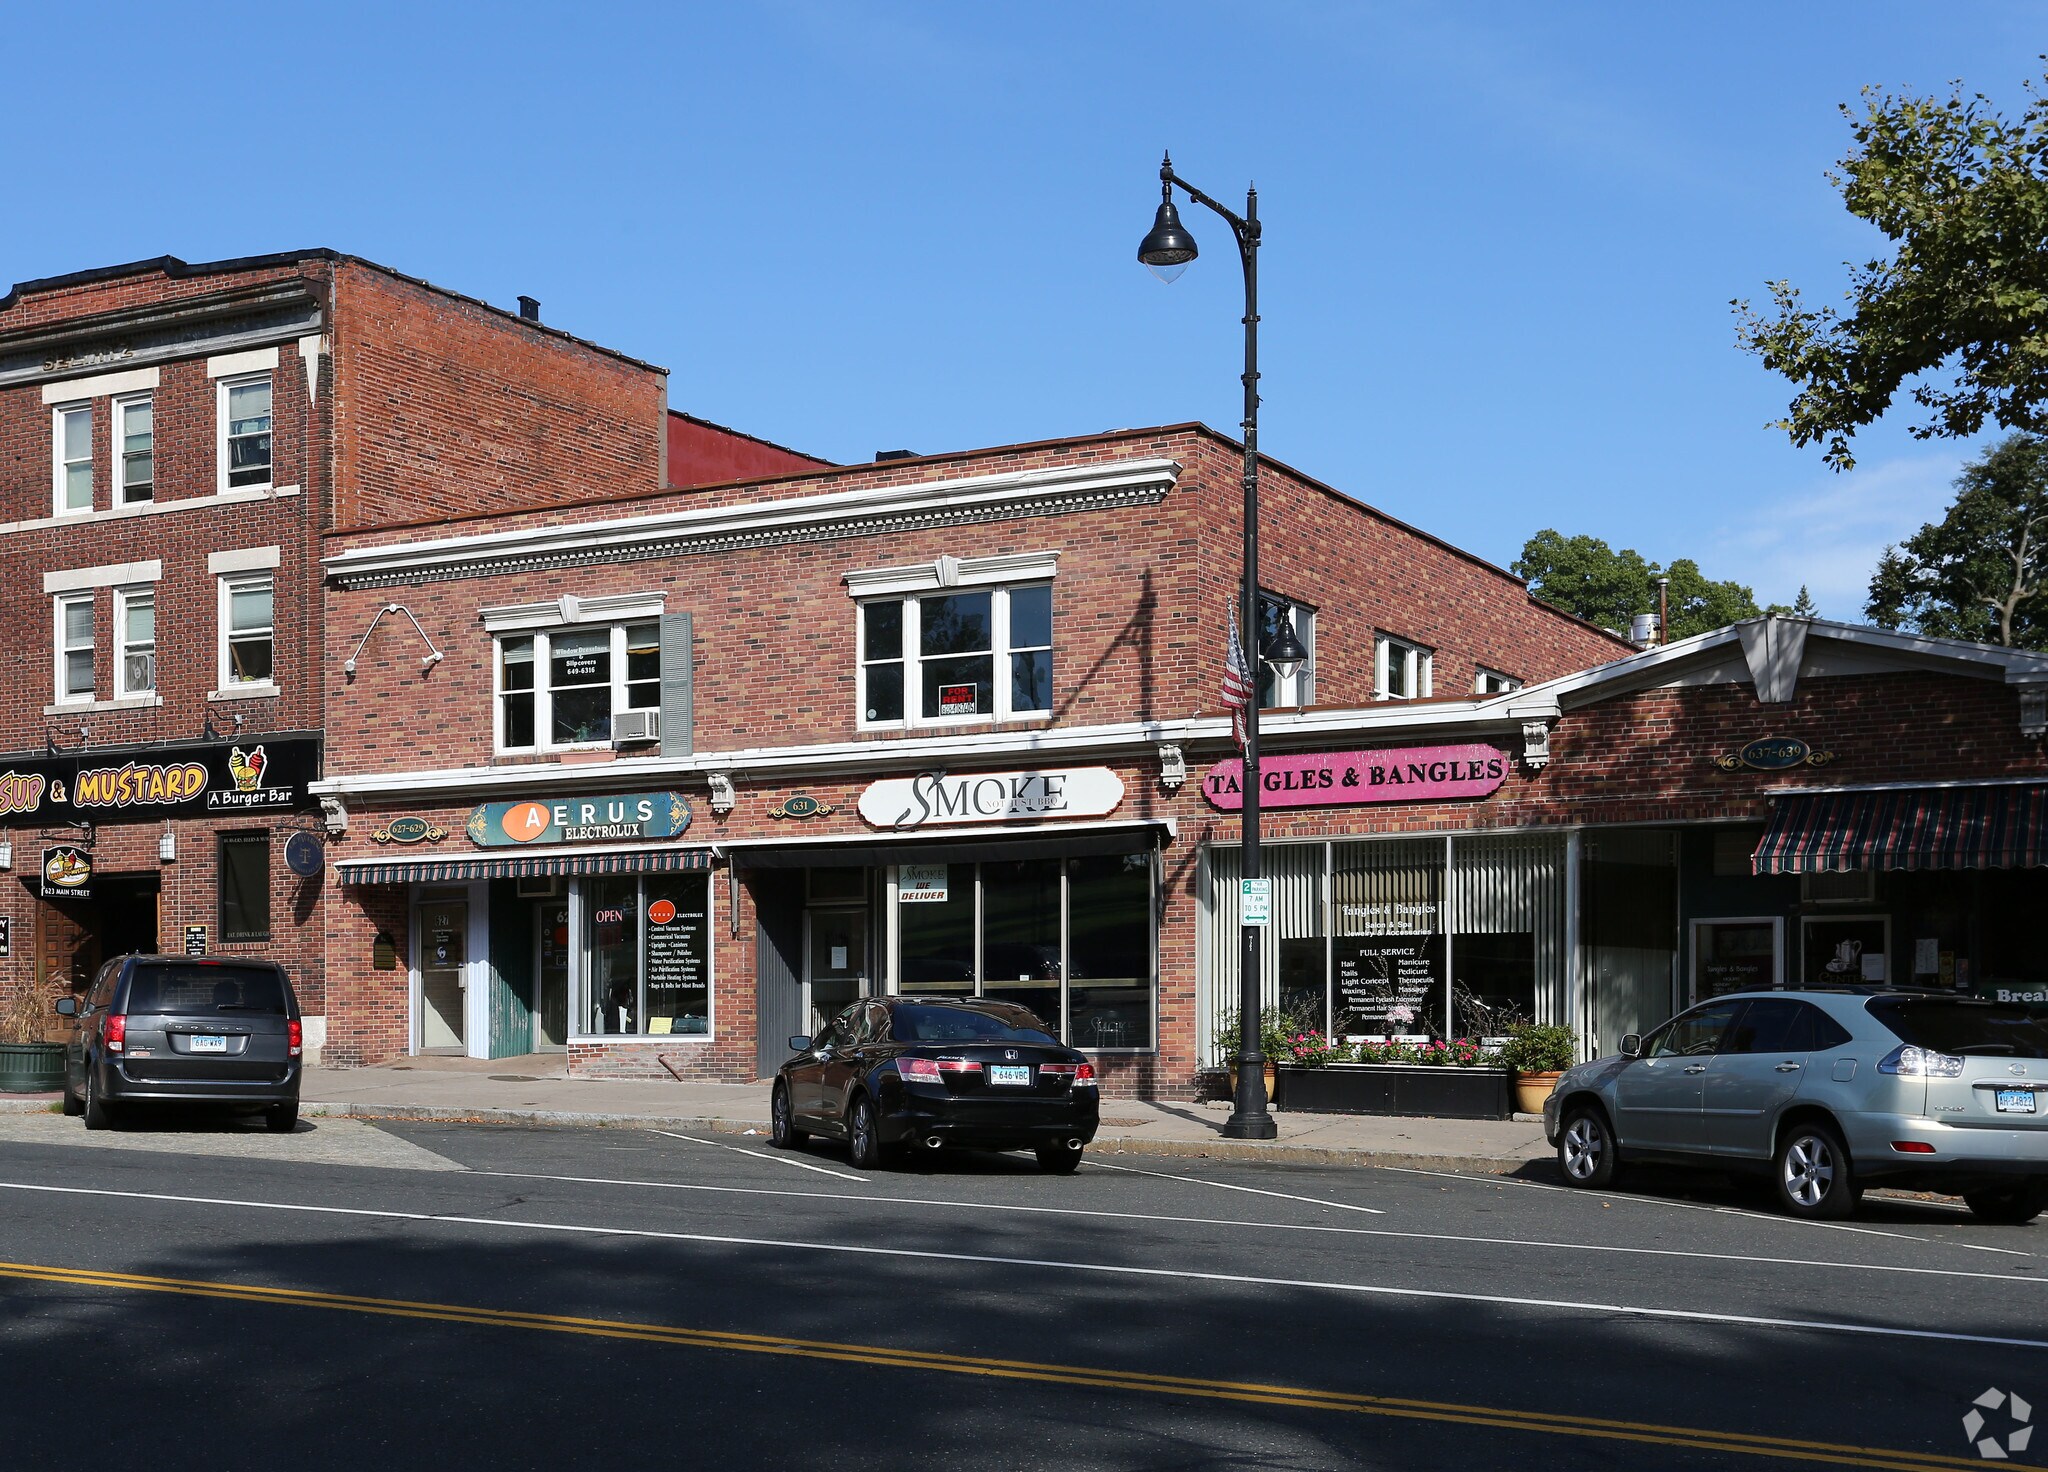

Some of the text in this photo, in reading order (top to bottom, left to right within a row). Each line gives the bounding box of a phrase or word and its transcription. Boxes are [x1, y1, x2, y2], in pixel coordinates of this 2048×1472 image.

[566, 659, 597, 668] Slipcovers
[567, 667, 596, 675] 649-6316
[948, 687, 968, 695] FOR
[943, 694, 973, 704] RENT
[1748, 745, 1801, 759] 637-639
[1208, 758, 1503, 794] TAGLES & BANGLES
[51, 780, 66, 801] &
[76, 763, 206, 806] MUSTARD
[209, 789, 292, 807] A Burger Bar
[895, 770, 1068, 830] SMOKE
[986, 797, 1058, 809] NOT JUST BBQ
[792, 801, 808, 811] 631
[525, 800, 654, 828] AERUS
[392, 823, 424, 834] 627-629
[565, 823, 640, 840] ELECTROLUX
[901, 865, 945, 882] SMOKE
[1244, 882, 1250, 892] 2
[901, 891, 945, 900] DELIVER
[1245, 904, 1252, 912] TO
[1253, 904, 1258, 912] 5
[1341, 902, 1436, 918] Tangles & Bangles
[595, 909, 623, 923] OPEN
[1365, 920, 1412, 929] Salon & Spa
[1381, 948, 1415, 956] SERVICE
[681, 965, 696, 973] Systems
[1341, 977, 1389, 986] Light Concept
